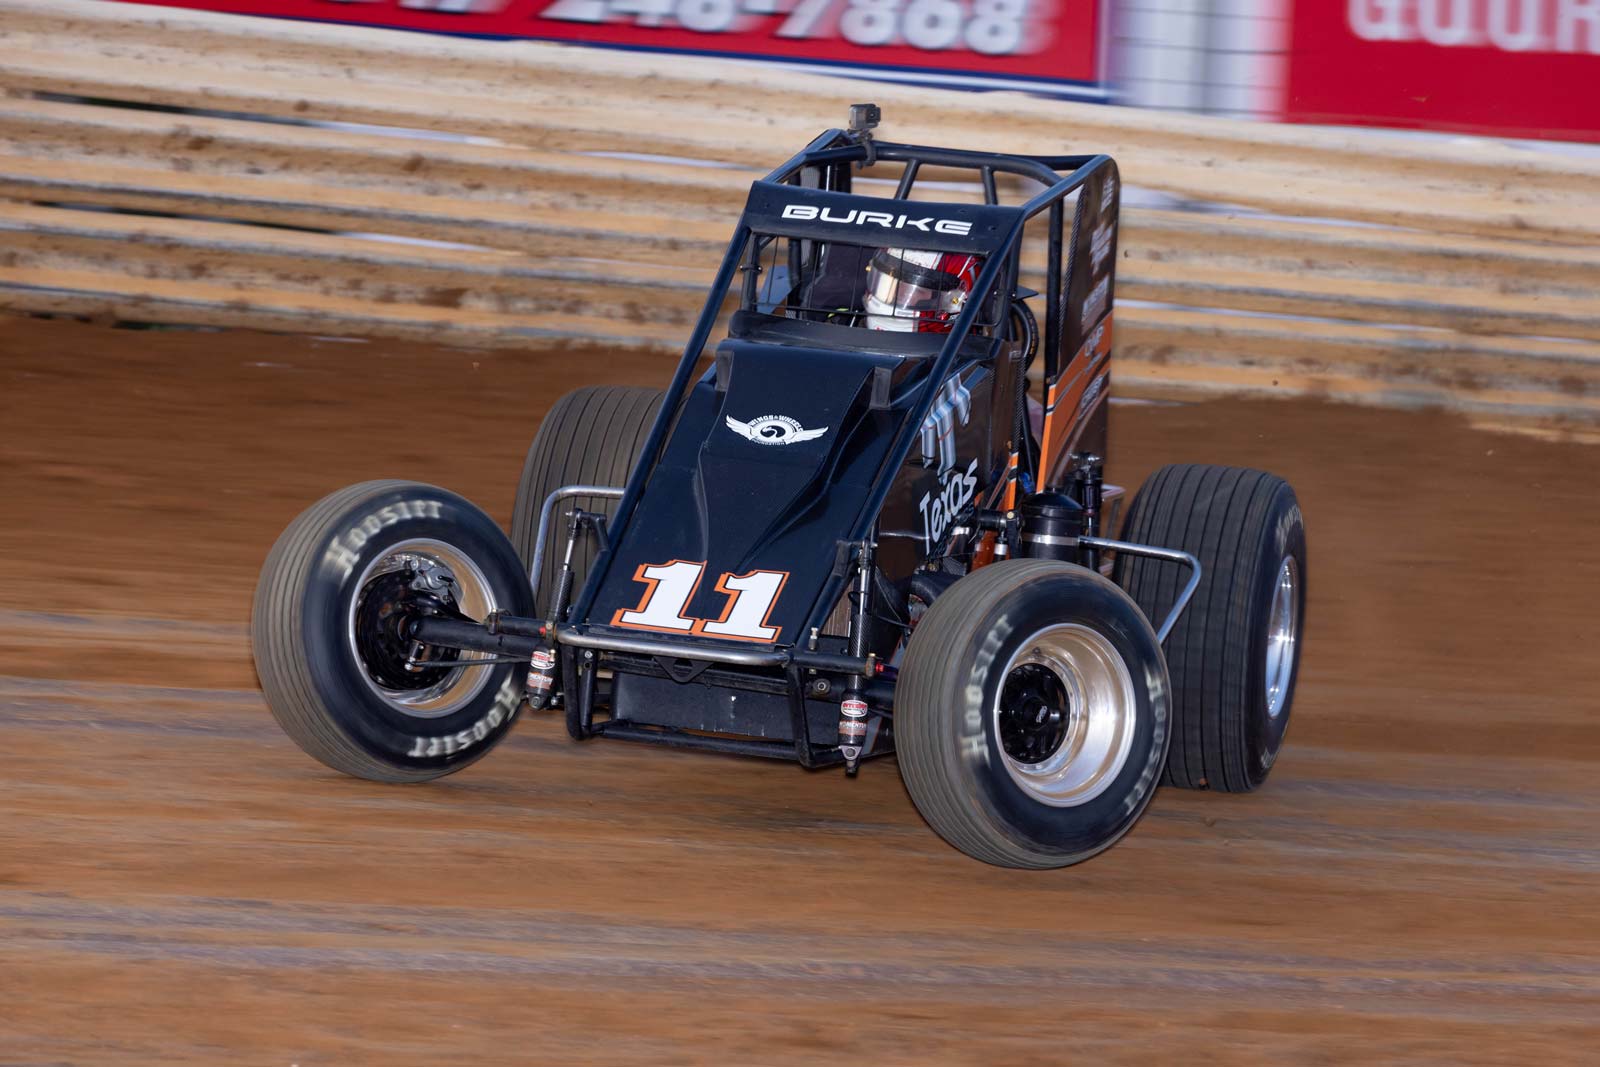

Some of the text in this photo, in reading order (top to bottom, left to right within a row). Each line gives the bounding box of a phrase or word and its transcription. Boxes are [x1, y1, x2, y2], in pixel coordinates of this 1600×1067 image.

[781, 204, 974, 236] BURKE
[919, 457, 978, 556] Texas
[610, 559, 791, 644] 11
